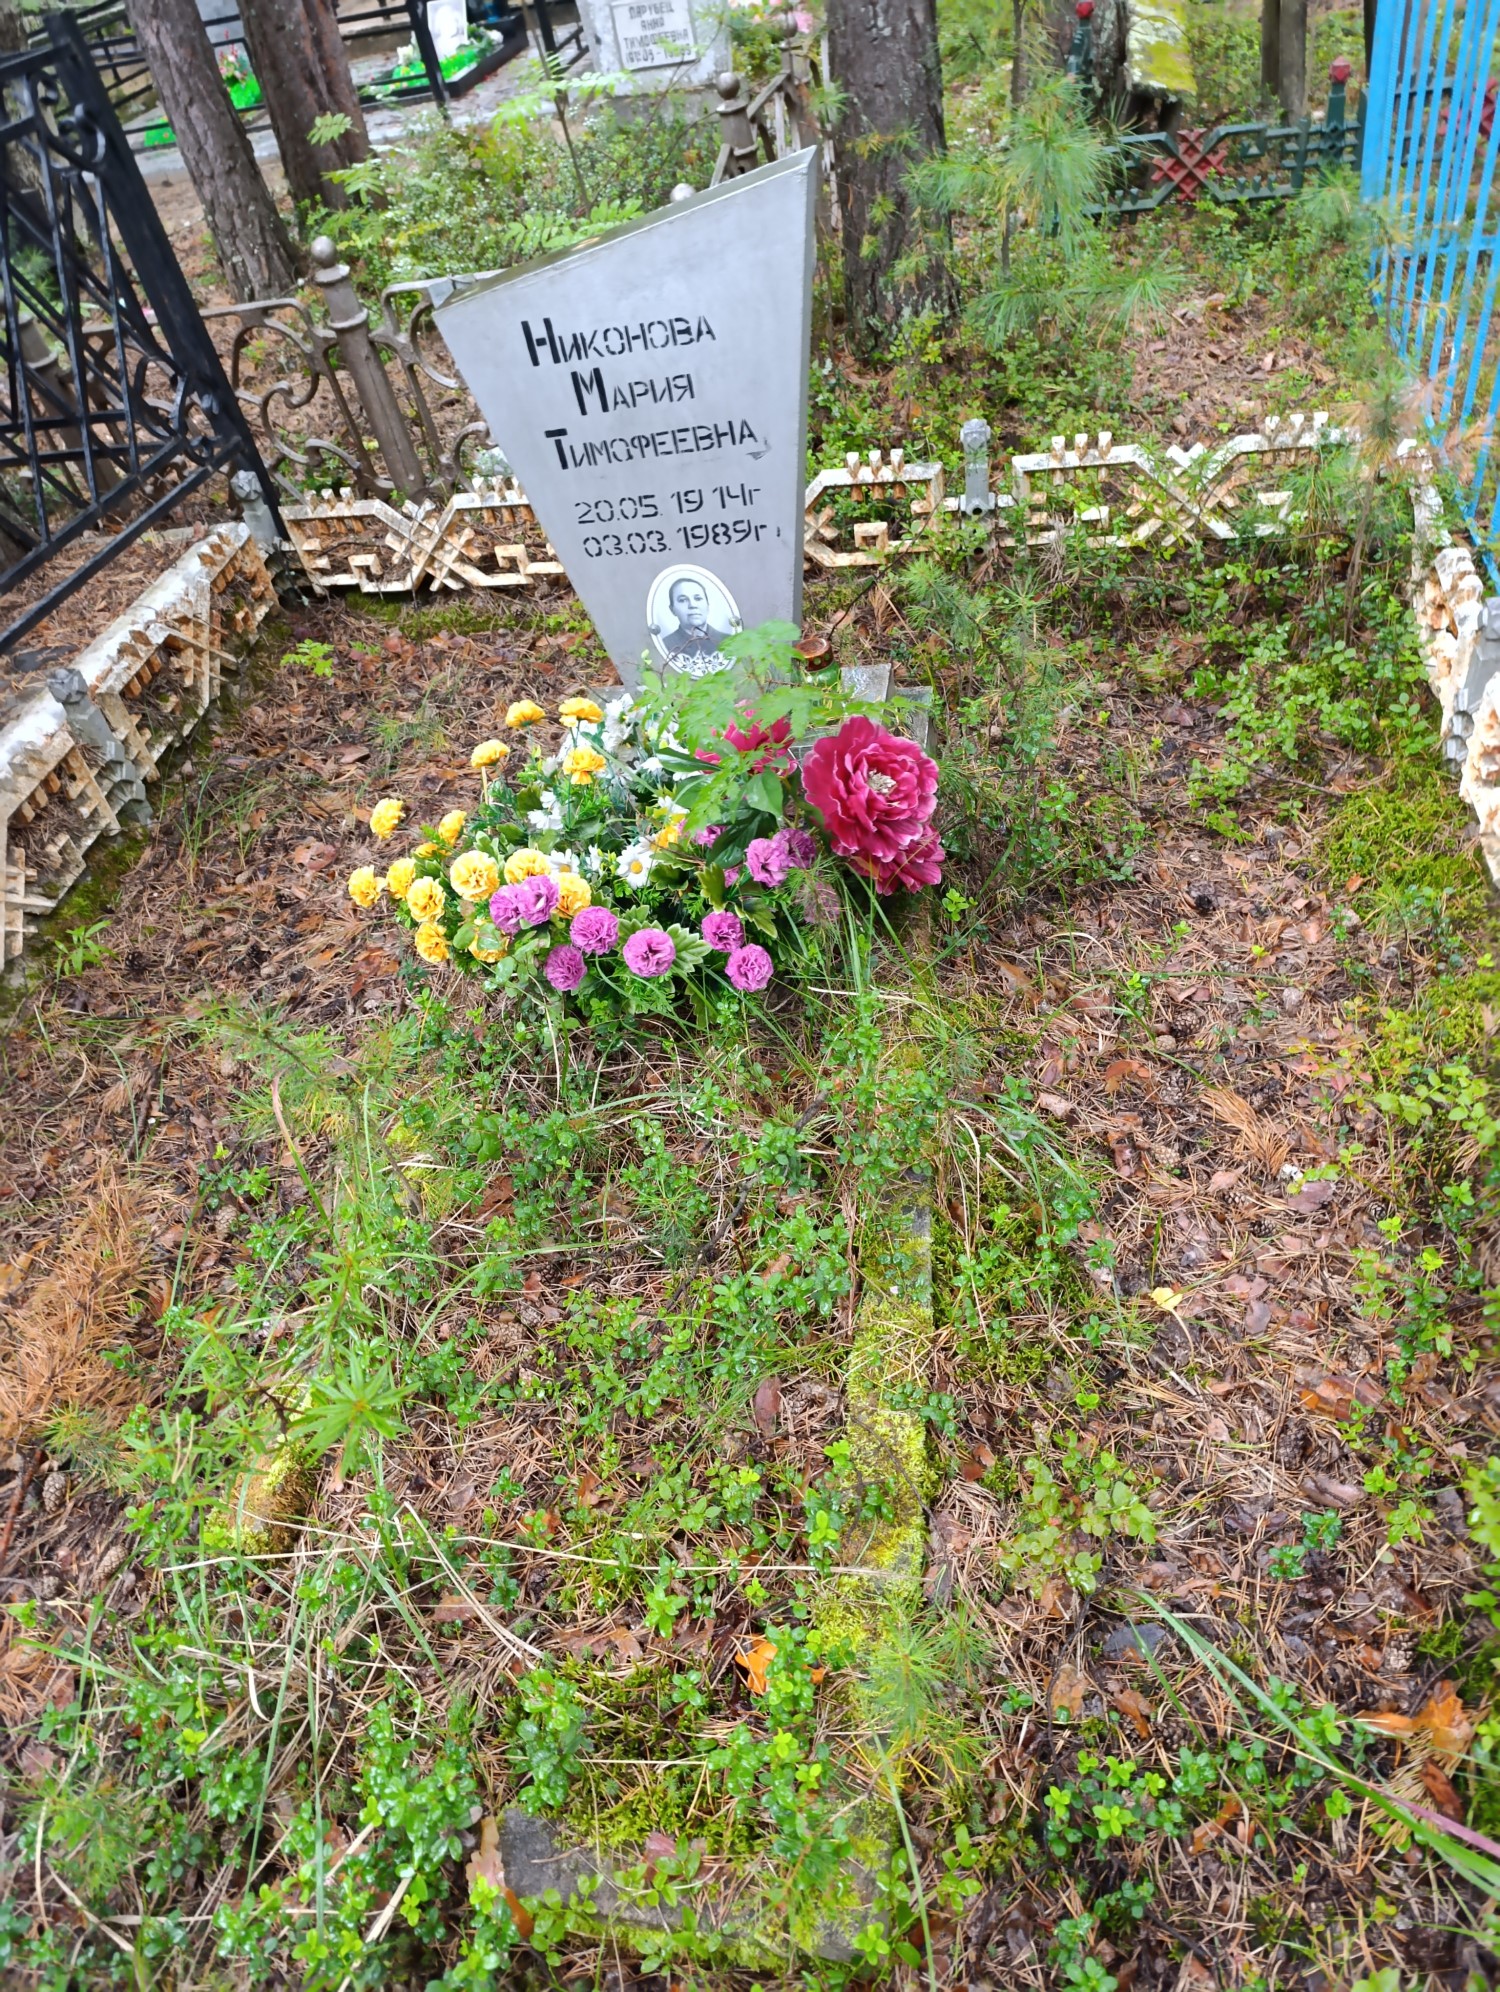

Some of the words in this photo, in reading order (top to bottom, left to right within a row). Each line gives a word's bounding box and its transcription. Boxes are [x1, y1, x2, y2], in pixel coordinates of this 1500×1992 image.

[521, 315, 716, 367] НИКОНОВА
[570, 367, 695, 416] МАРИЯ
[544, 419, 758, 470] ТИМОФЕЕВНА
